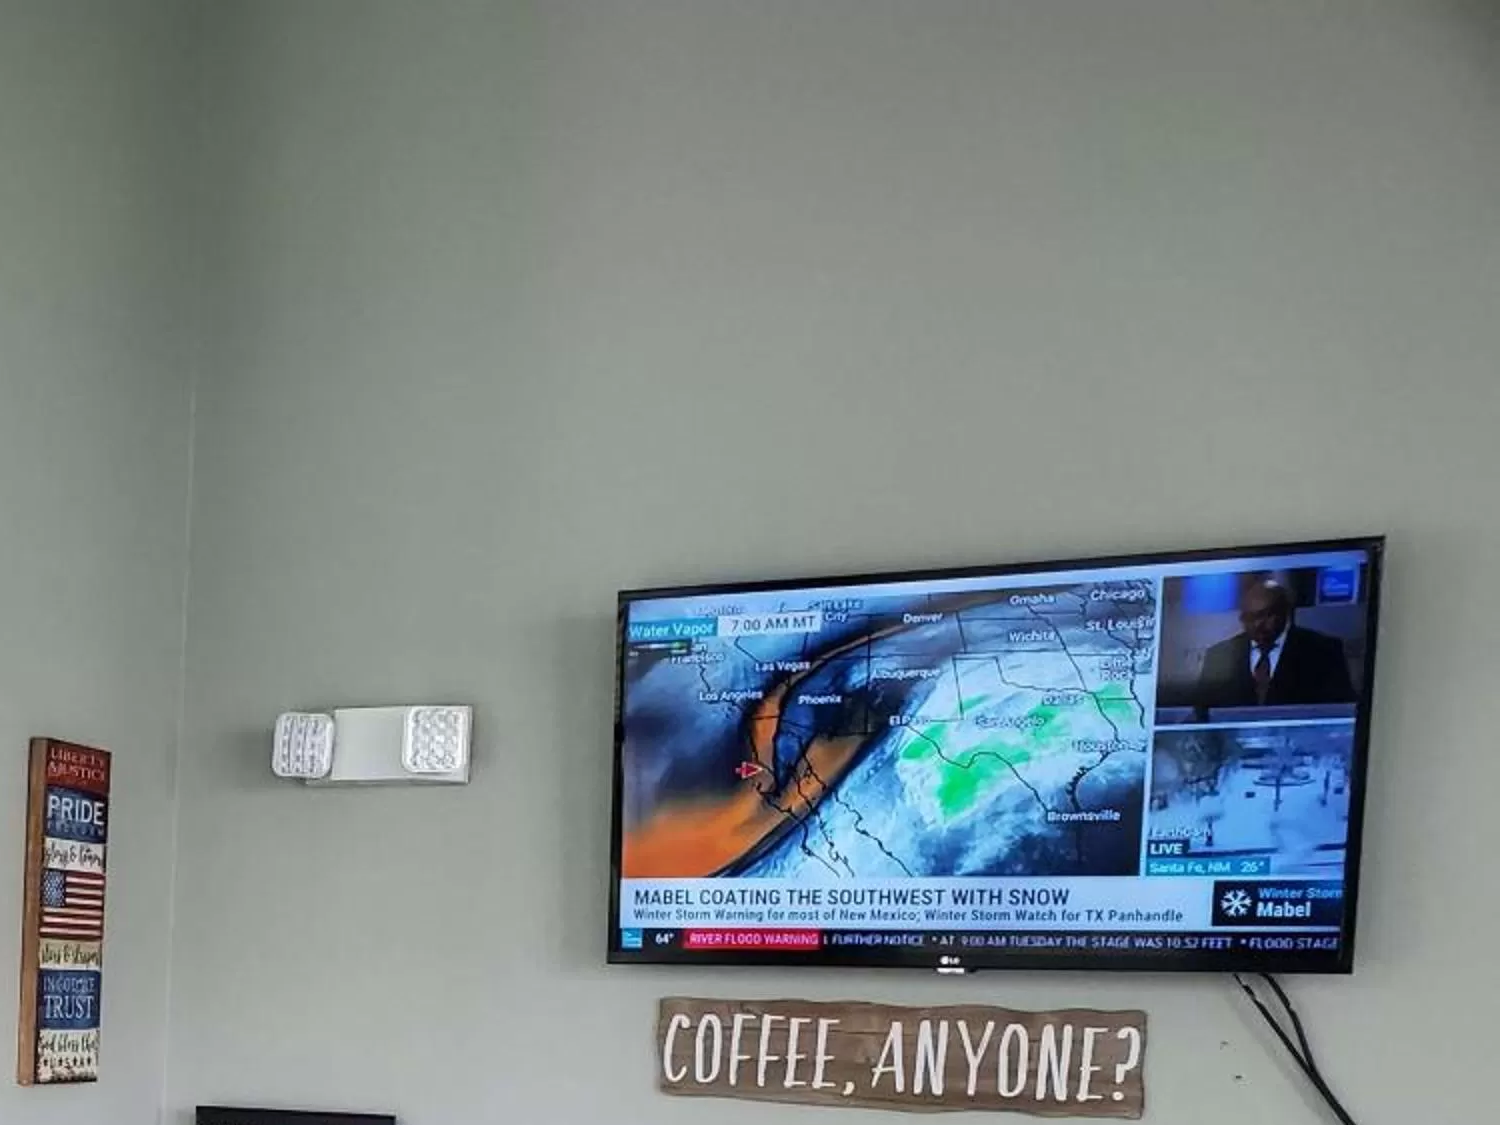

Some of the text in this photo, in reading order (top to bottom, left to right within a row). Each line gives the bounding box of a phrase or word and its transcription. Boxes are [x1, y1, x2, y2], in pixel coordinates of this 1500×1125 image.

[1009, 595, 1056, 606] Omaha
[1090, 589, 1146, 602] Chicago
[764, 617, 789, 630] AM
[793, 616, 816, 628] MT
[903, 612, 943, 624] Denver
[630, 621, 714, 639] Water Vapor
[1008, 630, 1057, 642] Wichita
[755, 660, 811, 673] Las Vegas
[699, 689, 763, 702] Los Angeles
[798, 693, 843, 705] Phoenix
[47, 794, 105, 826] PRIDE
[1047, 810, 1121, 822] Brownsville
[1150, 844, 1183, 855] LIVE
[1150, 862, 1184, 873] Santa
[1207, 862, 1231, 873] NM
[634, 888, 1070, 906] MABEL COATING THE SOUTHWEST WITH SNOW
[1257, 887, 1301, 899] Winter
[633, 909, 1184, 923] Winter Storm Warning for most of New Mexico; Winter Storm Watch for TX Panhandle
[1256, 901, 1312, 918] Mabel
[689, 933, 819, 945] RIVER FLOOD WARNING
[884, 934, 924, 946] NOTICE
[1009, 935, 1063, 947] TUESDAY
[1091, 935, 1130, 947] STAGE
[1134, 936, 1163, 948] WAS
[1201, 937, 1233, 948] FEET
[1250, 937, 1294, 949] FLOOD
[43, 995, 95, 1019] TRUST
[662, 1013, 1141, 1101] COFFEE, ANYONE?
